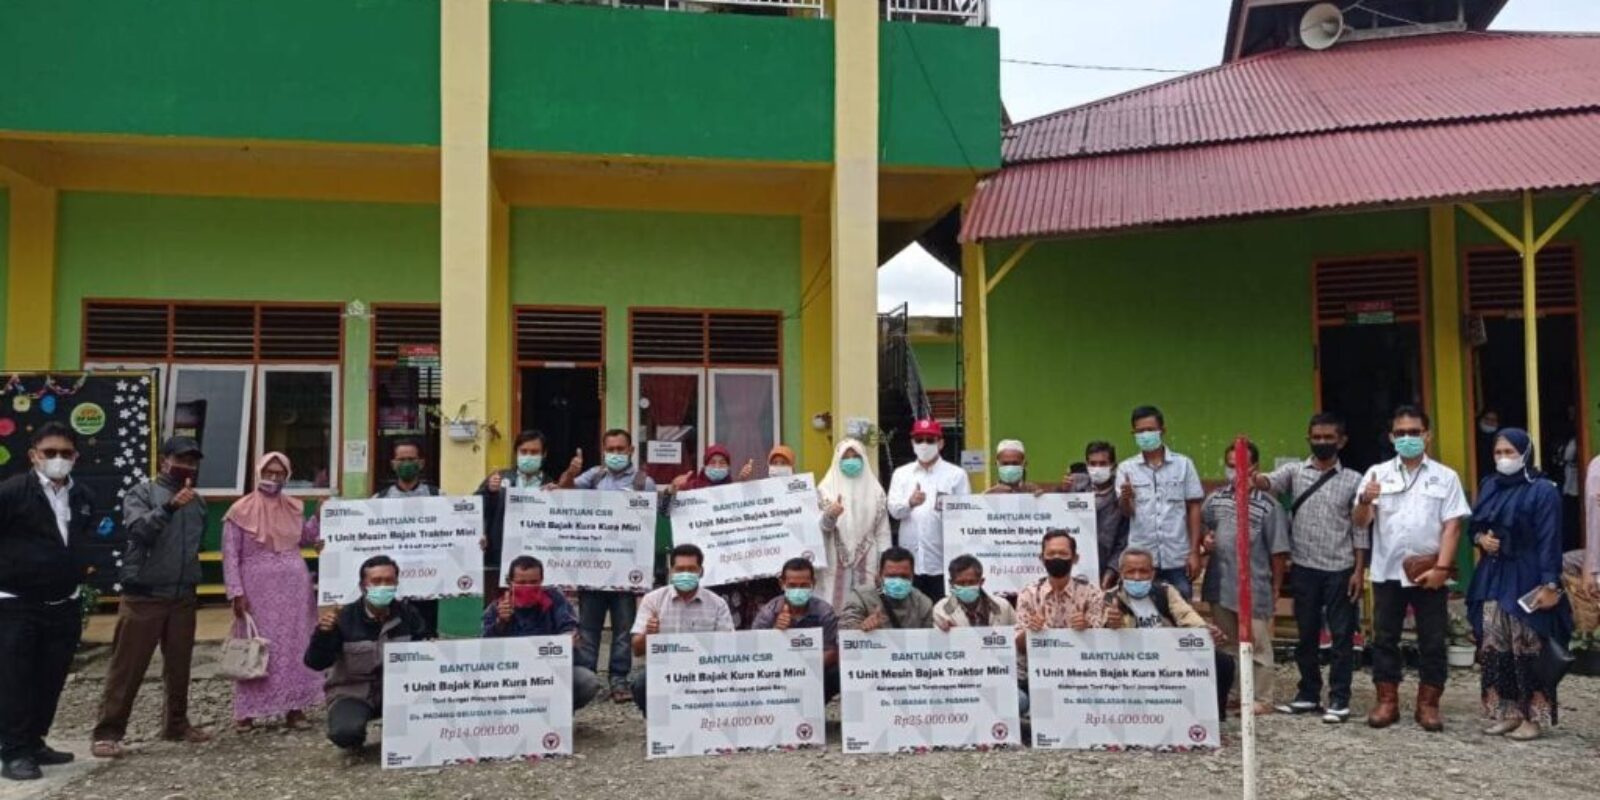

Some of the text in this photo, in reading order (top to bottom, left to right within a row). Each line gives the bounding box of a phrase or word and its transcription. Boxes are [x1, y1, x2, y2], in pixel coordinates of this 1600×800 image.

[713, 500, 755, 512] BANTUAN
[368, 518, 415, 526] BANTUAN
[695, 520, 714, 528] Unit
[716, 516, 742, 525] Mesin
[744, 512, 768, 521] Bajak
[770, 507, 802, 517] Singkal
[548, 522, 572, 530] Bajak
[1018, 527, 1042, 536] Bajak
[335, 533, 356, 542] Unit
[358, 532, 387, 541] Mesin
[390, 530, 416, 540] Bajak
[419, 529, 452, 538] Traktor
[456, 528, 476, 536] Mini
[1179, 637, 1204, 648] SIG
[538, 645, 563, 656] SIG
[891, 651, 965, 661] BANTUAN CSR
[1081, 652, 1159, 661] BANTUAN CSR
[699, 653, 772, 665] BANTUAN CSR
[440, 661, 519, 674] BANTUAN CSR
[848, 666, 1009, 679] 1 Unit Mesin Bajak Traktor Mini
[666, 668, 806, 684] 1 Unit Bajak Kura Kura Mini
[1067, 669, 1097, 678] Mesin
[1100, 669, 1128, 679] Bajak
[1132, 669, 1156, 678] Kura
[1159, 669, 1183, 678] Kura
[1186, 669, 1209, 677] Mini
[403, 676, 554, 693] 1 Unit Bajak Kura Kura Mini
[701, 715, 774, 731] Rp14.000.000
[1085, 713, 1164, 726] Rp14.000.000
[440, 724, 520, 740] Rp14.000.000
